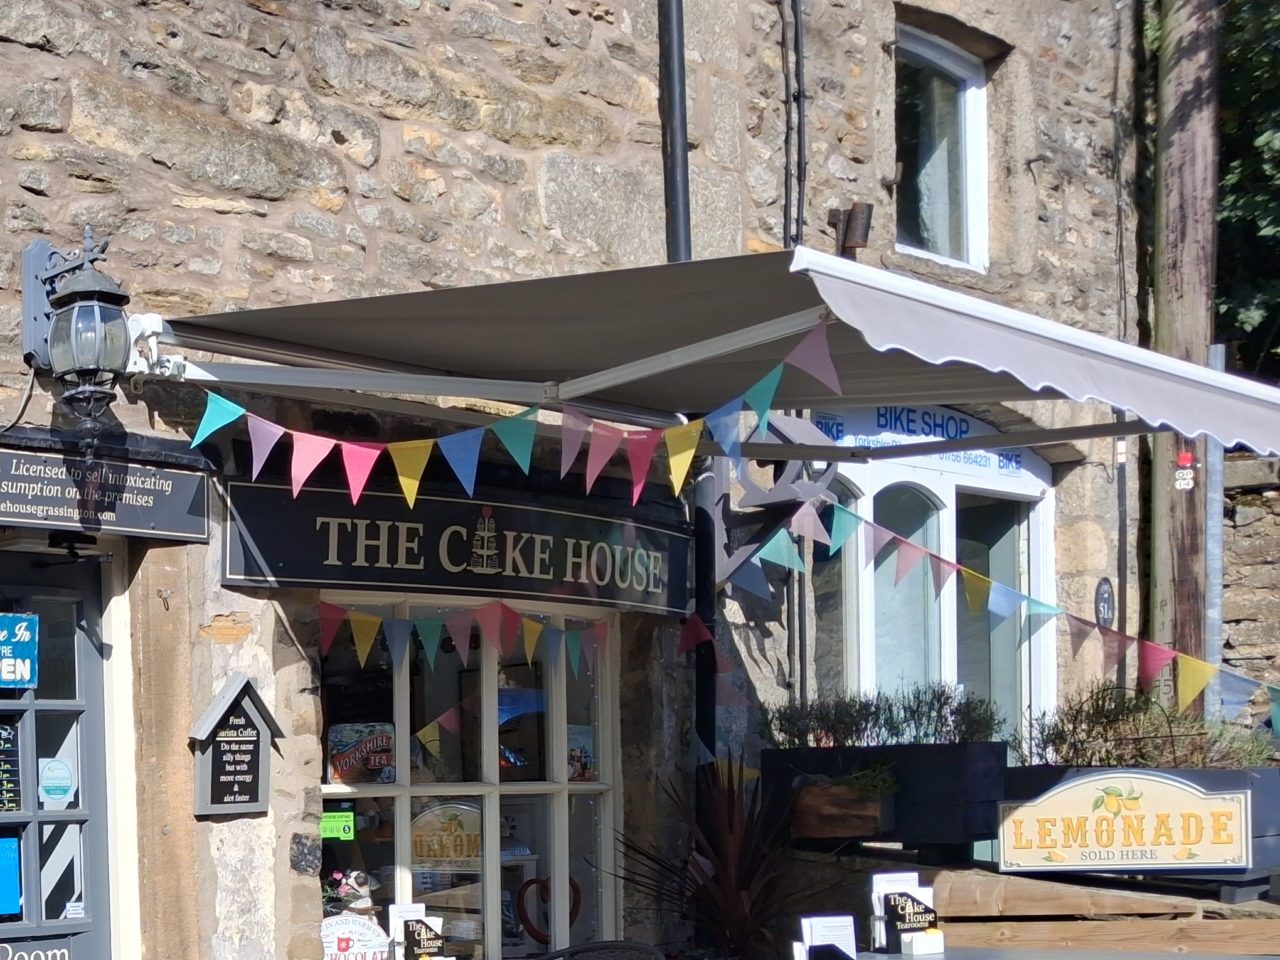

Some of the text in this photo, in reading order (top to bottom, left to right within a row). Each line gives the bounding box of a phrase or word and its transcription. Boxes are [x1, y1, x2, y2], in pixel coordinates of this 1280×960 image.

[876, 406, 969, 440] BIKE SHOP
[998, 453, 1021, 470] BIKE
[11, 459, 66, 479] Licensed
[70, 467, 82, 480] to
[86, 468, 105, 483] sell
[108, 471, 172, 495] intoxicating
[65, 486, 81, 499] on
[84, 486, 102, 501] the
[102, 489, 154, 507] premises
[316, 516, 424, 570] THE
[562, 538, 663, 594] HOUSE
[11, 621, 32, 642] In
[229, 716, 246, 725] Fresh
[238, 728, 257, 737] Coffee
[235, 752, 251, 762] things
[336, 736, 389, 774] YORKSHIRE
[370, 755, 388, 767] TEA
[226, 763, 248, 771] but with
[235, 774, 253, 782] energy
[1012, 811, 1234, 850] LEMONADE
[1080, 850, 1158, 861] SOLD HERE
[889, 894, 907, 905] The
[905, 912, 935, 923] House
[408, 921, 422, 931] The
[421, 939, 443, 948] House
